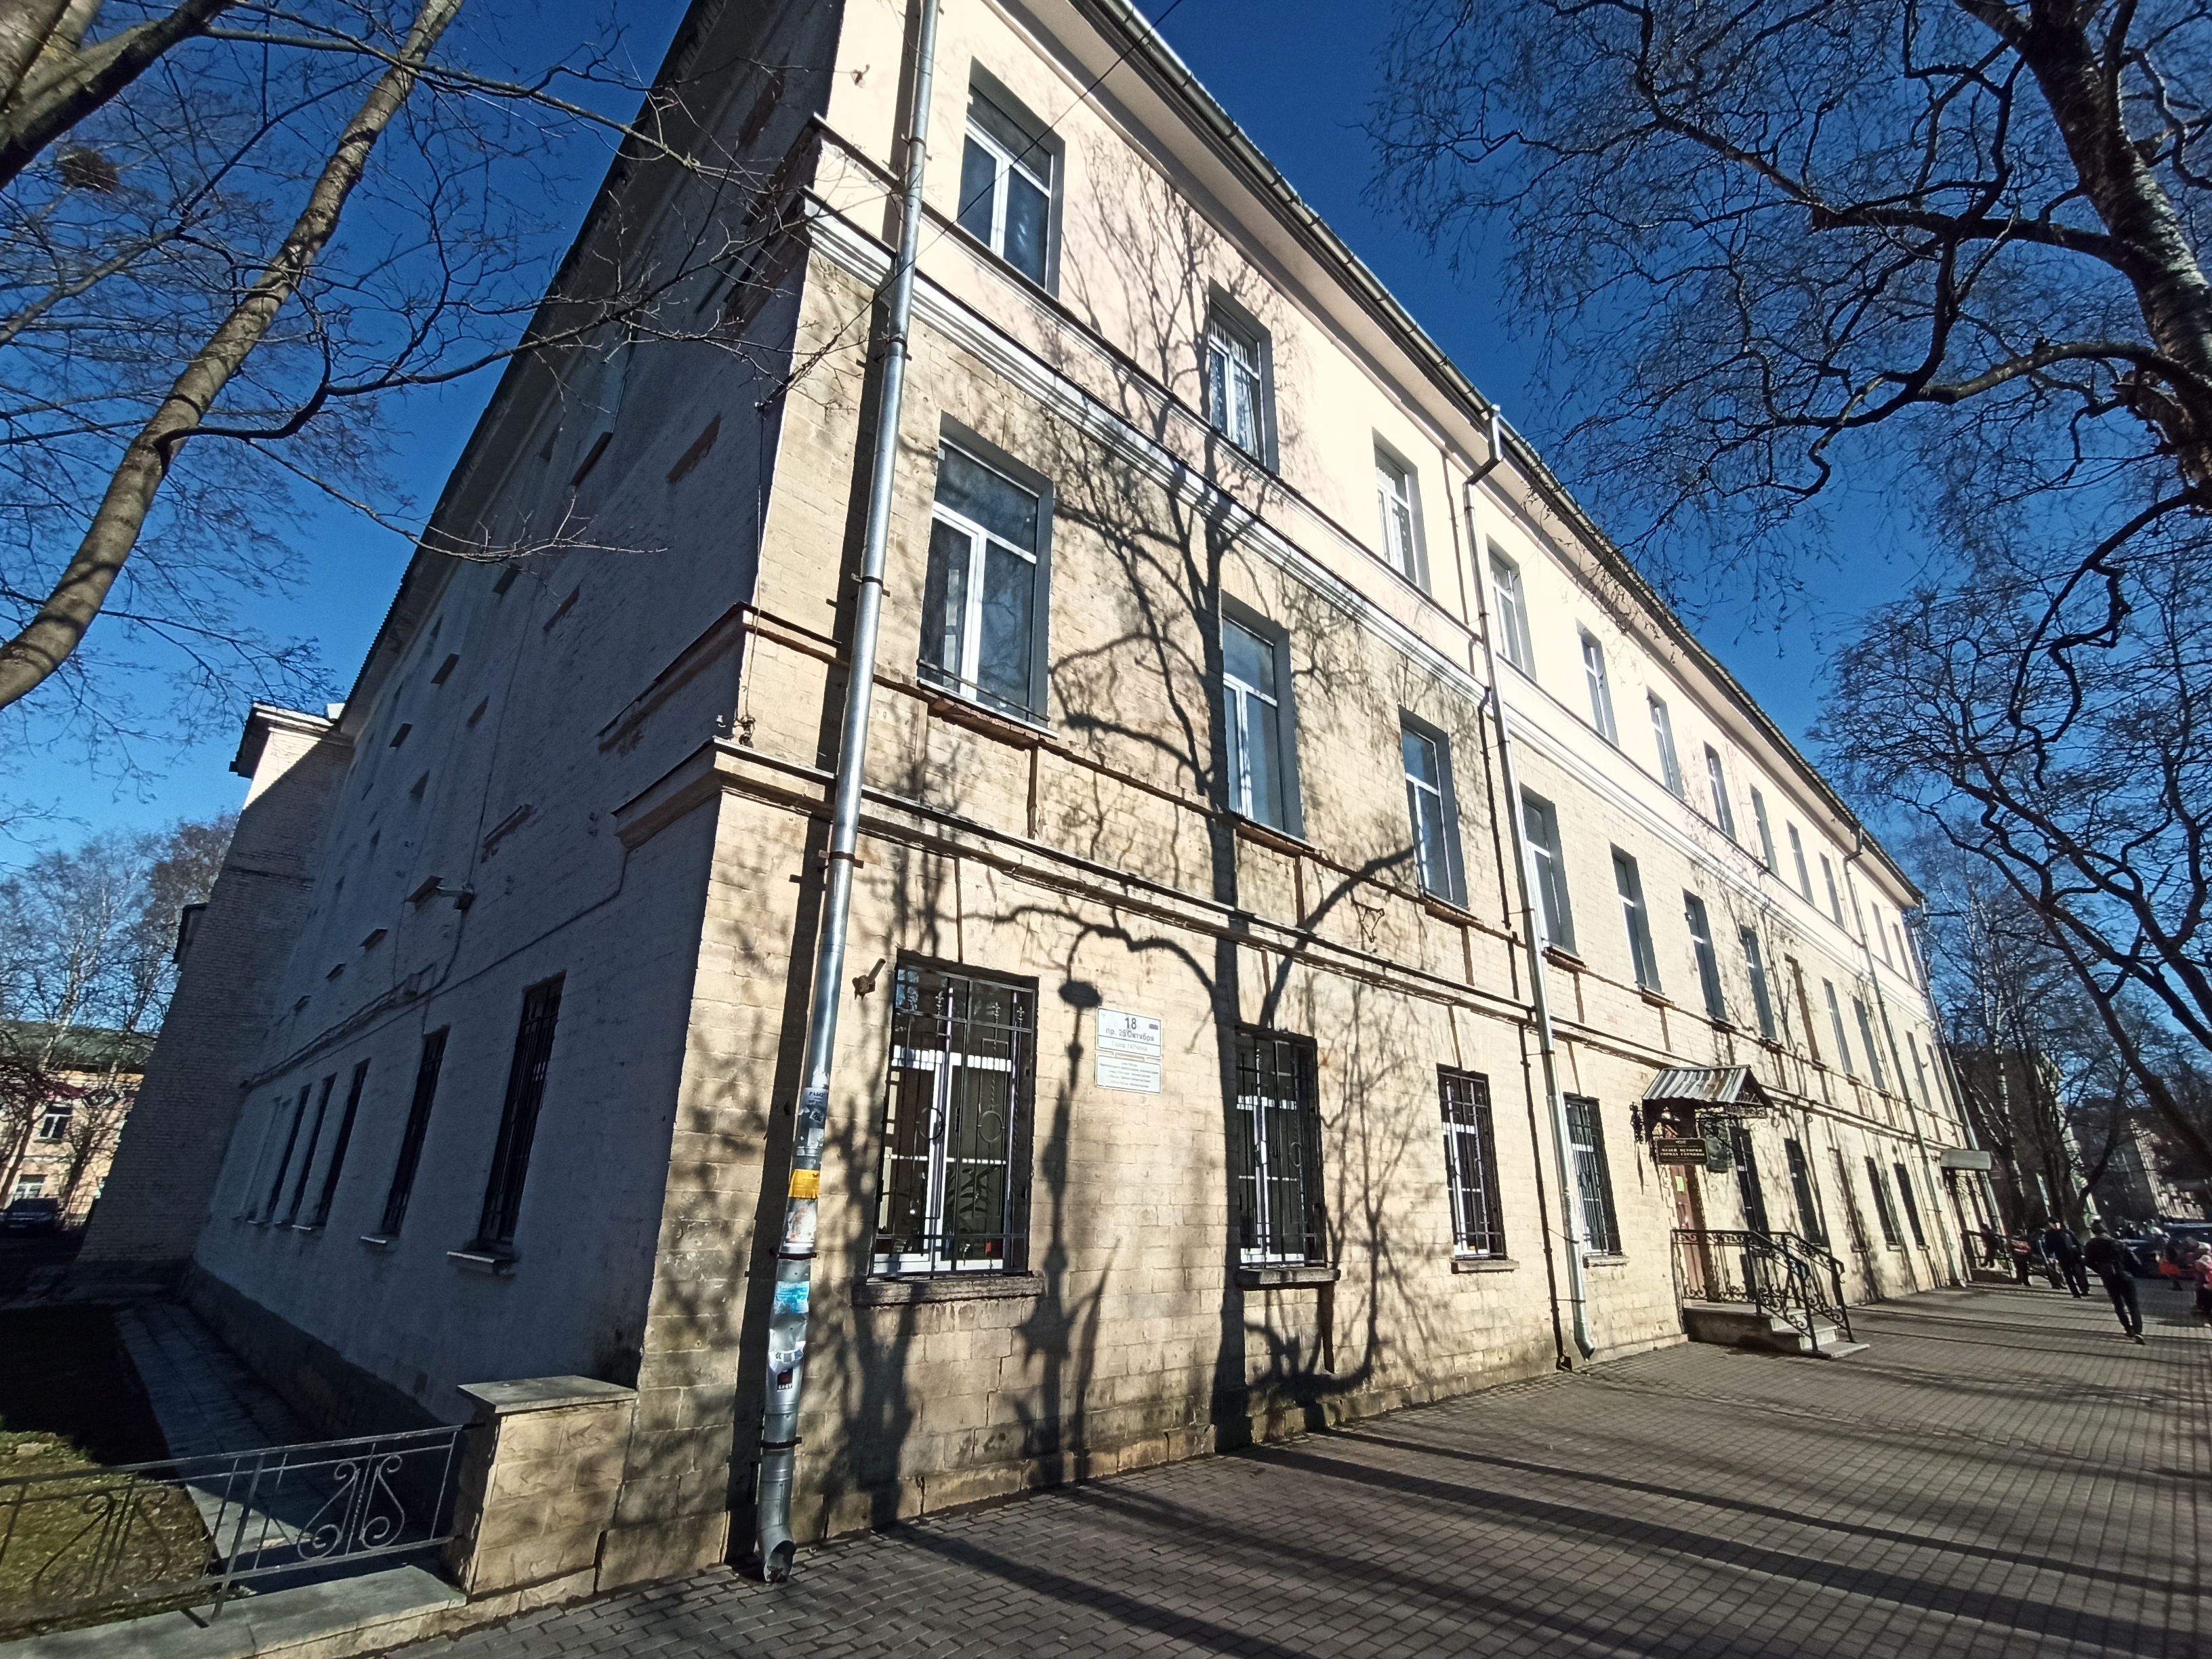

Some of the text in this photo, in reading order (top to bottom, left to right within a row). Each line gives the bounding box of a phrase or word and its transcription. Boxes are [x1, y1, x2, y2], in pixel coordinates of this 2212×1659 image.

[1125, 1017, 1136, 1029] 18
[1119, 1029, 1126, 1037] 25
[1127, 1030, 1154, 1042] Октября
